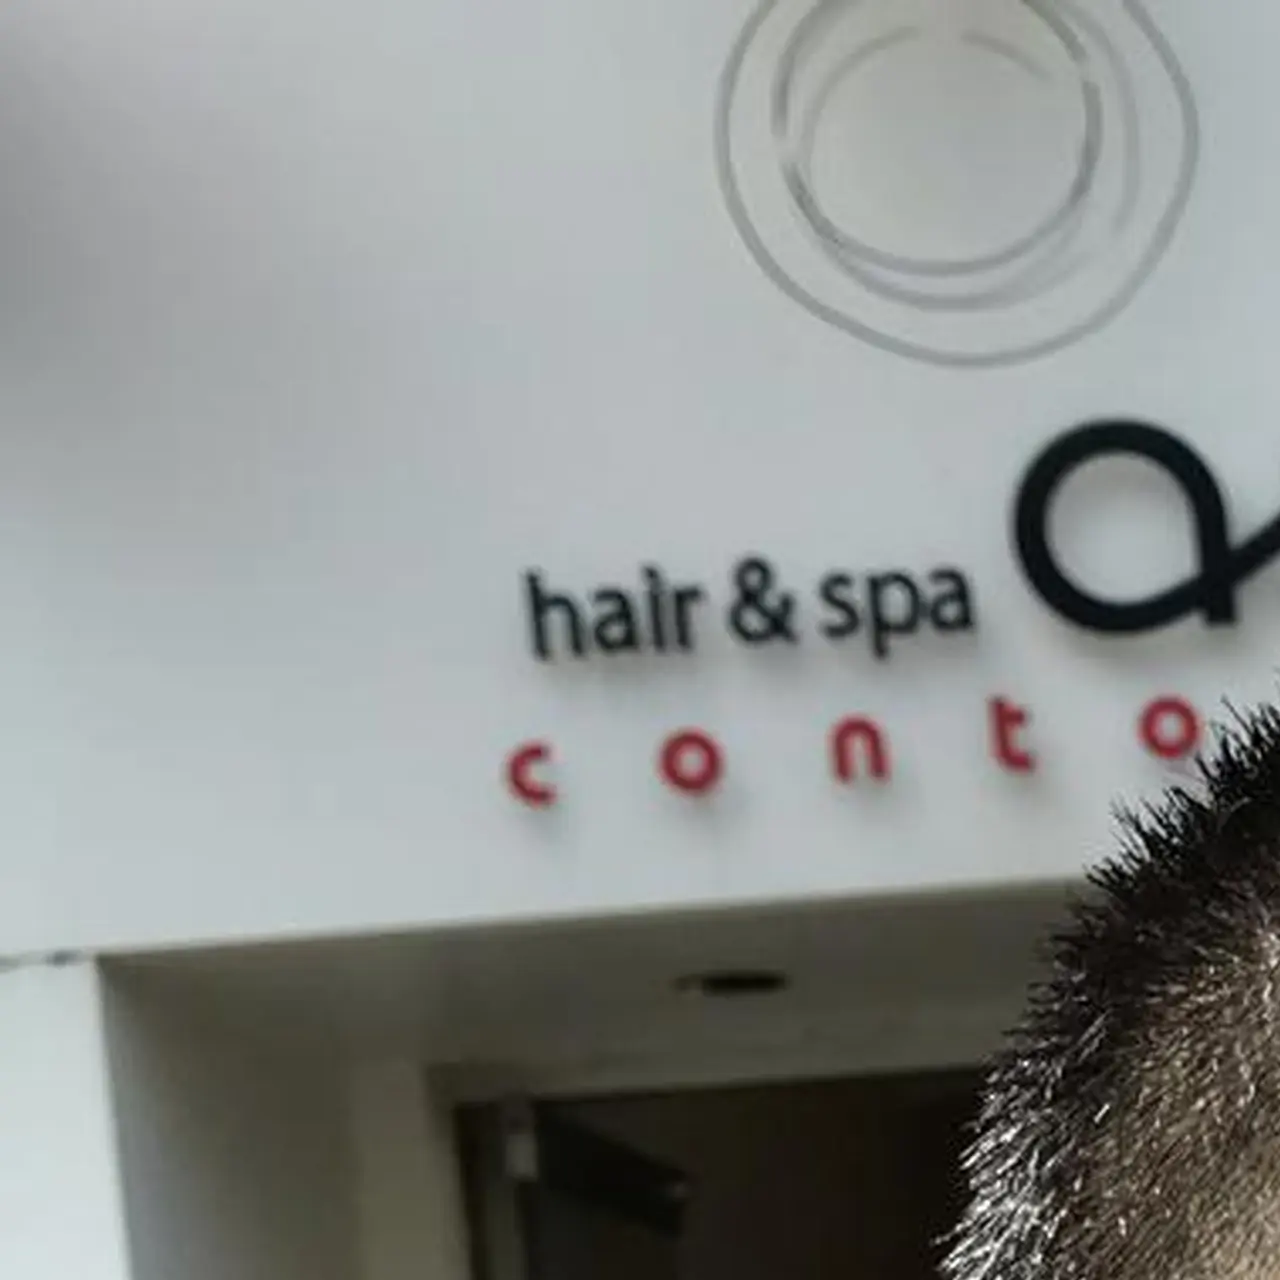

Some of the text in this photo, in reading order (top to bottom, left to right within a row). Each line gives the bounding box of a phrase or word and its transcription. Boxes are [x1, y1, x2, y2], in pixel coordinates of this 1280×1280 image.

[525, 566, 704, 663] hair
[727, 556, 800, 648] &
[818, 567, 978, 663] spa
